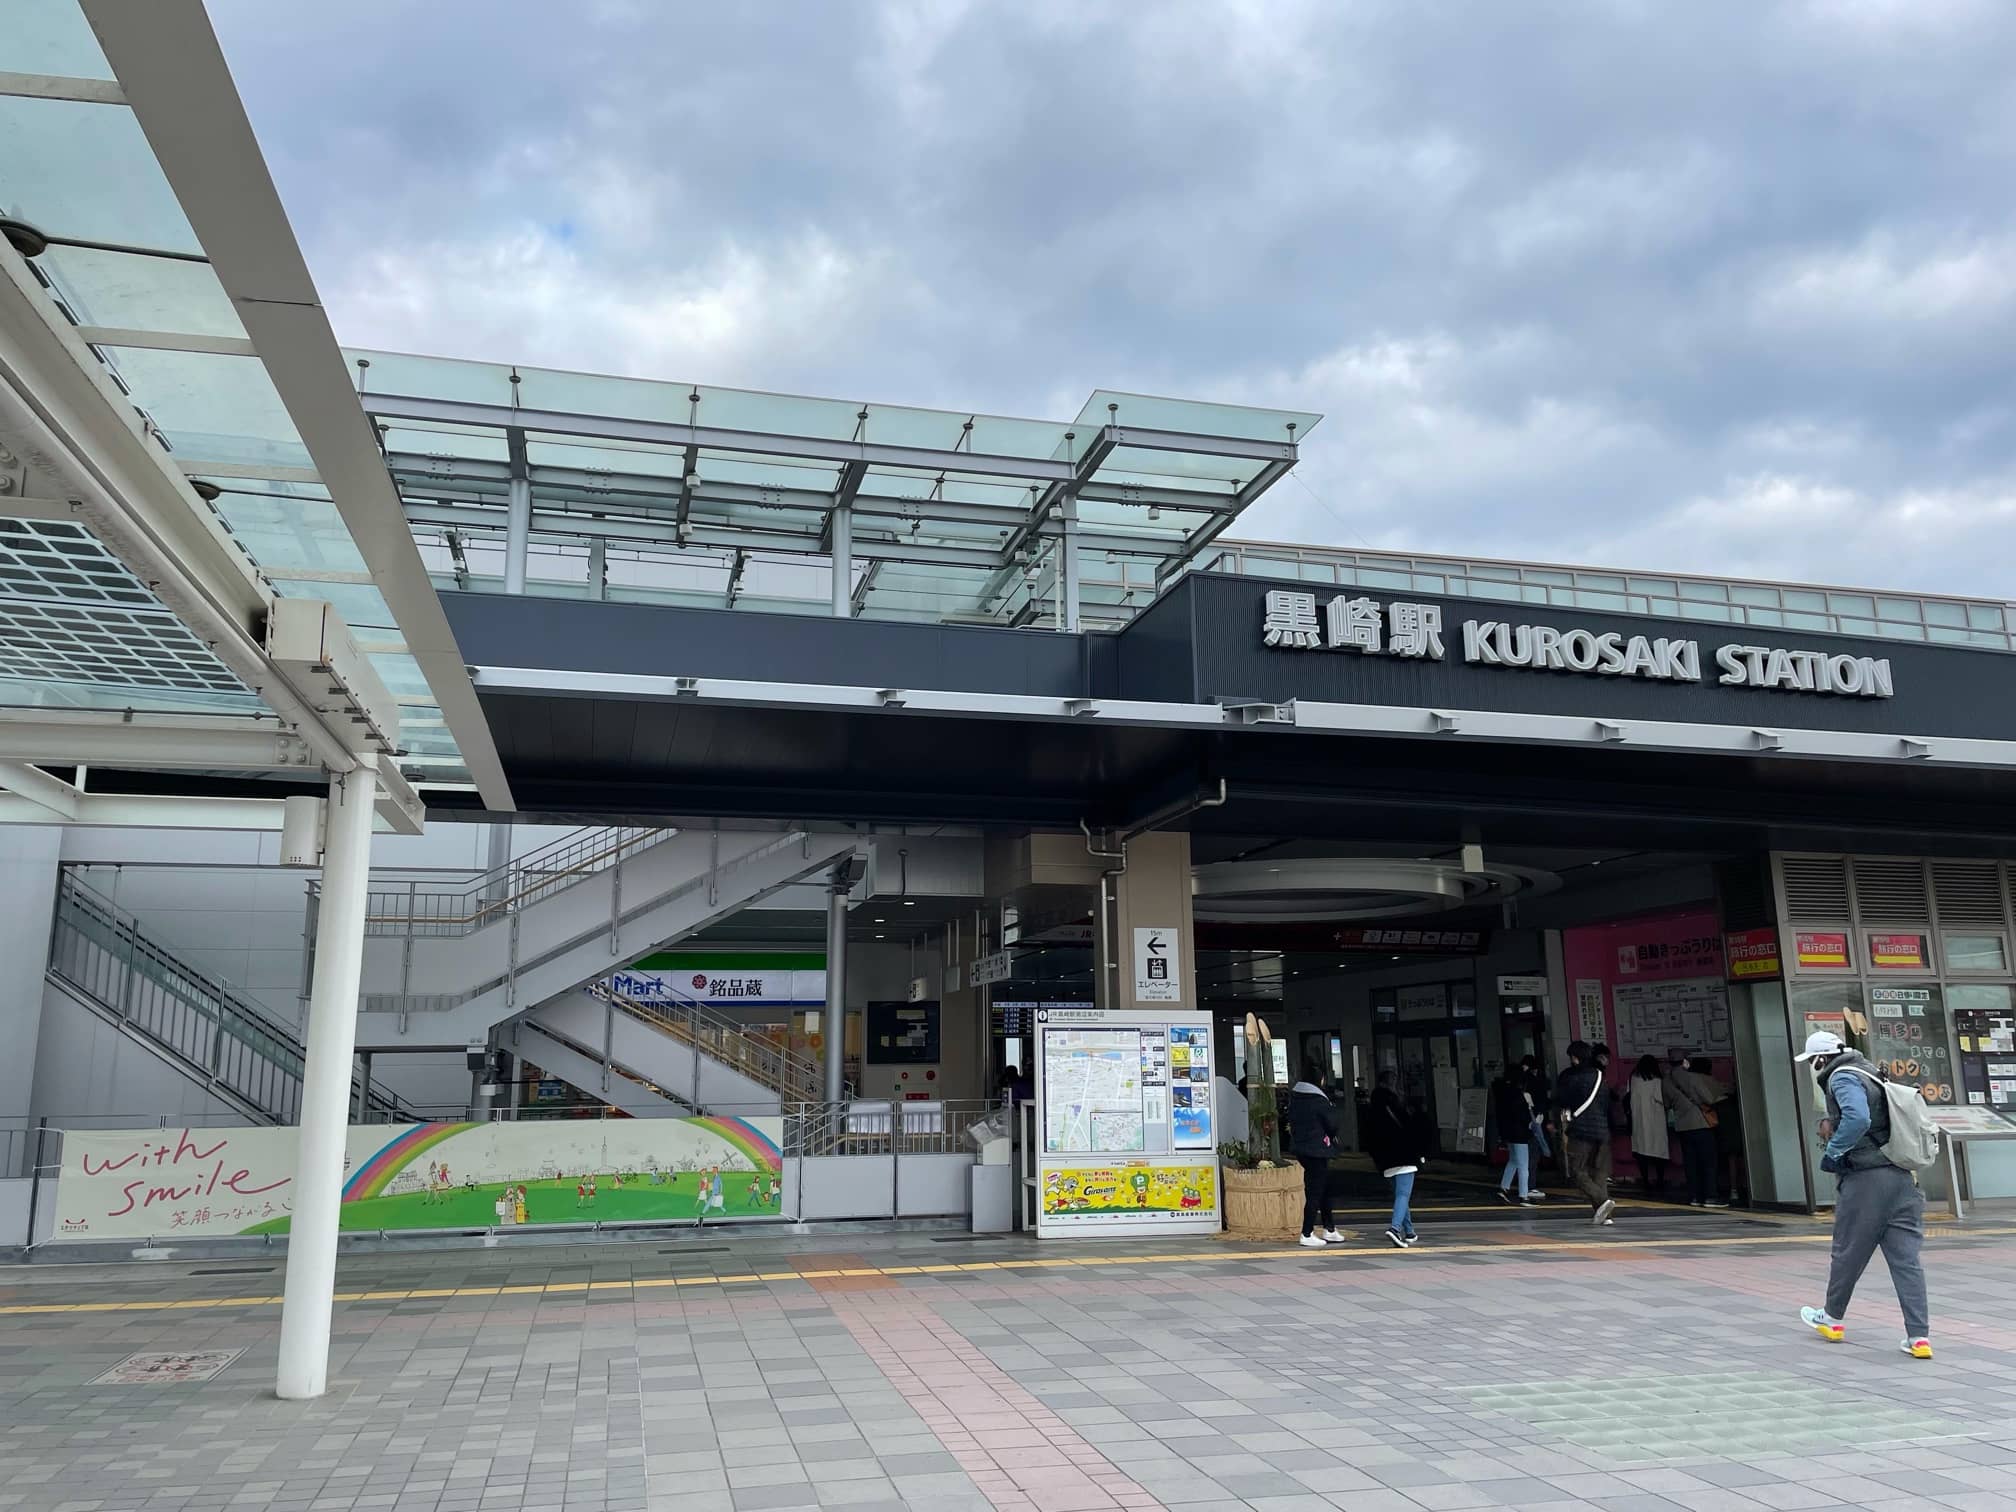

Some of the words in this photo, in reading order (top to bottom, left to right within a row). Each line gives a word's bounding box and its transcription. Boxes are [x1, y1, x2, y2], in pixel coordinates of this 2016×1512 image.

[1263, 590, 1444, 661] 黒崎駅
[1462, 619, 1701, 681] KUROSAKI
[1716, 643, 1894, 698] STATION
[1802, 943, 1843, 953] 旅行の窓口
[1878, 944, 1918, 953] 旅行の窓口
[709, 979, 763, 997] 銘品蔵
[1138, 980, 1179, 989] エレベーター
[83, 1128, 228, 1176] with
[108, 1160, 291, 1216] smile
